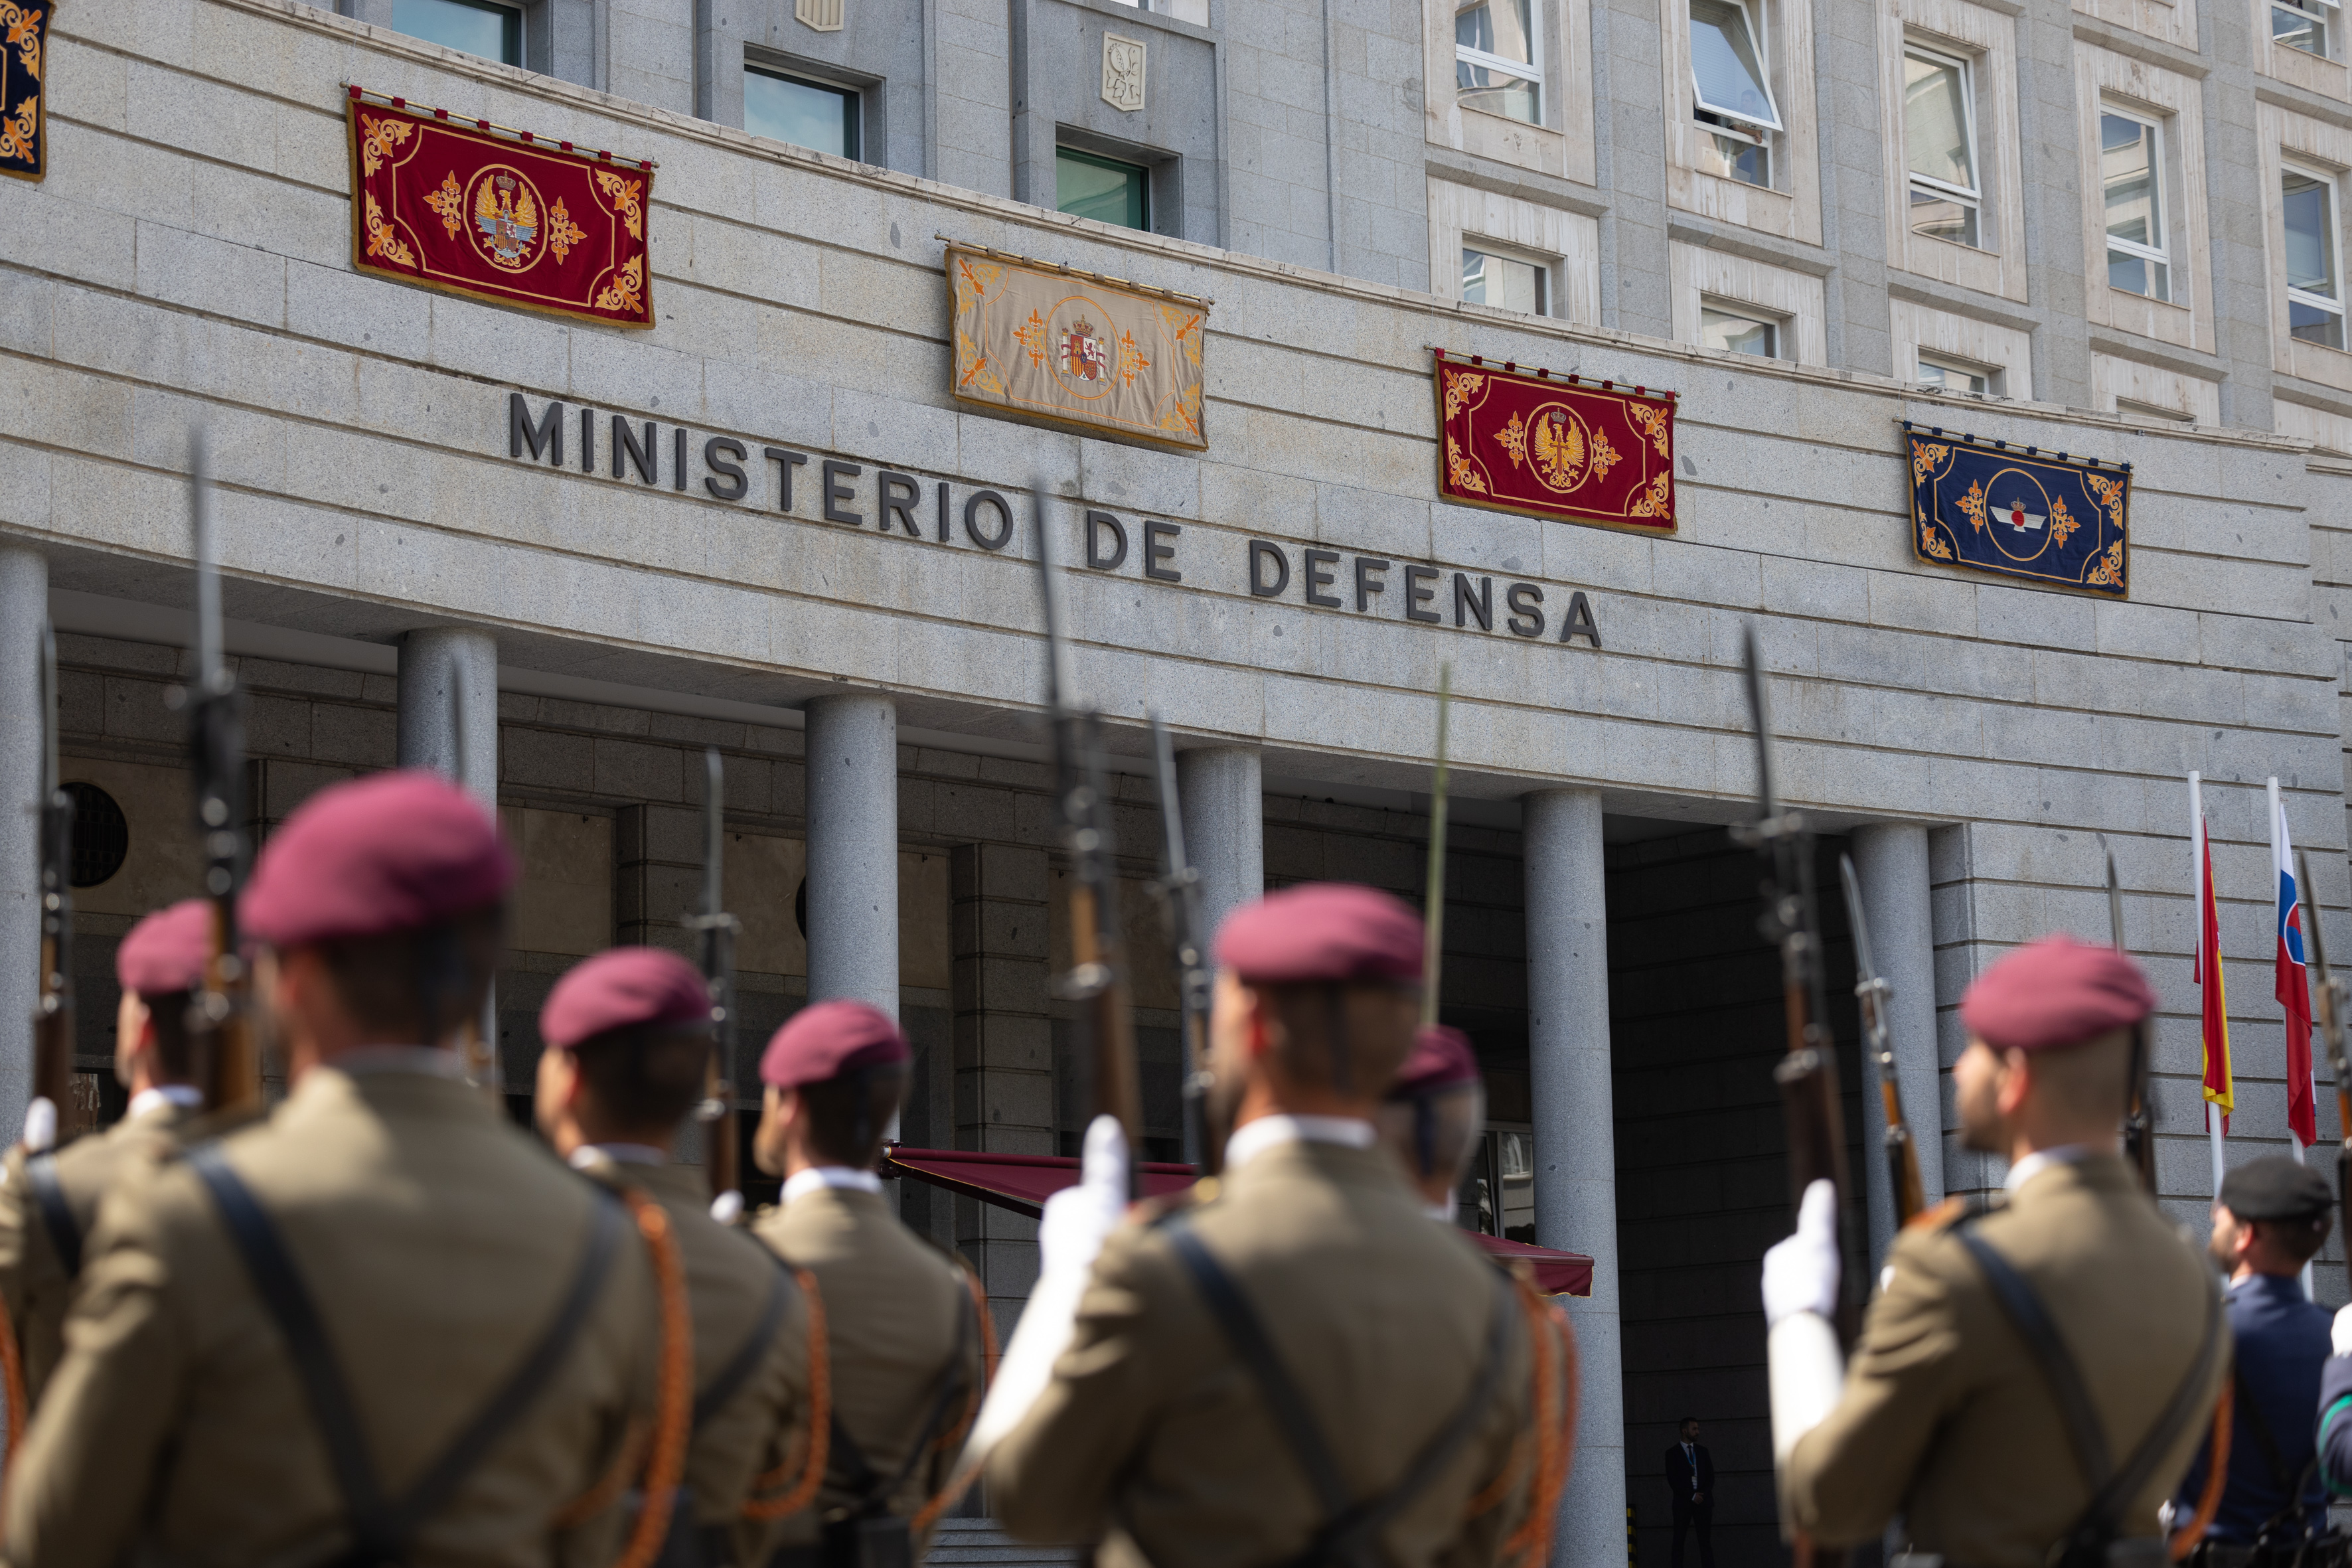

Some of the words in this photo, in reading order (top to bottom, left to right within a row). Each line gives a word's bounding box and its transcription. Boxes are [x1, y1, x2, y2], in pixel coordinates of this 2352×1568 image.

[510, 393, 1014, 550] MINISTERIO
[1087, 510, 1182, 582] DE
[1249, 539, 1603, 647] DEFENSA
